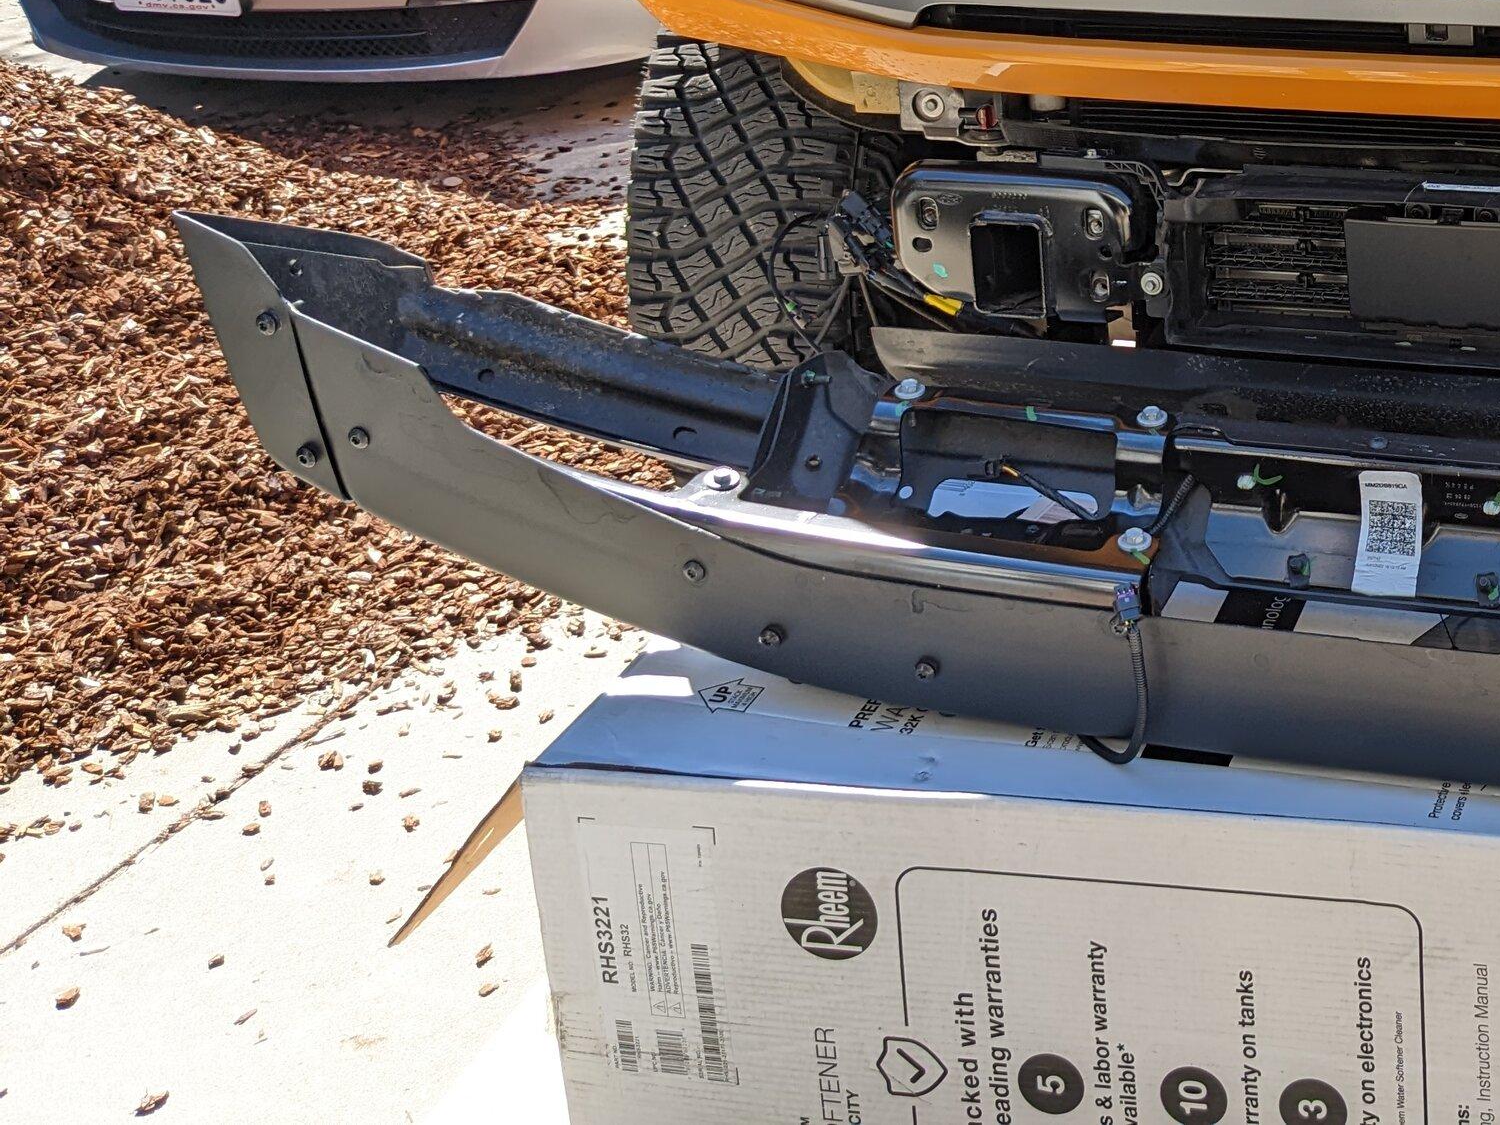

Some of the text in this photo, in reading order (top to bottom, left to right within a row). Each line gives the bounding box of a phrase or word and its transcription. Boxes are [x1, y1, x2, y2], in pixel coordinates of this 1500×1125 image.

[708, 686, 732, 703] UP
[899, 715, 925, 735] 32K
[1024, 732, 1044, 747] Get
[1428, 783, 1451, 819] Protective
[1451, 796, 1468, 821] covers
[783, 871, 864, 953] Rheem
[591, 895, 619, 985] RHS3221
[620, 924, 632, 957] RHS32
[979, 908, 1005, 1038] warranties
[1087, 940, 1108, 1031] warranty
[1473, 963, 1489, 1019] Manual
[1236, 970, 1255, 1028] tanks
[1354, 956, 1375, 1074] electronics
[954, 992, 977, 1048] with
[1393, 1011, 1403, 1044] Cleaner
[1093, 1037, 1112, 1089] labor
[1241, 1034, 1257, 1059] on
[1394, 1045, 1404, 1082] Softener
[1474, 1023, 1492, 1102] Instruction
[814, 1027, 843, 1125] FTENER
[1037, 1075, 1066, 1095] 5
[1360, 1079, 1376, 1105] on
[1094, 1095, 1113, 1110] &
[1178, 1080, 1208, 1116] 10
[1298, 1099, 1327, 1120] 3
[1396, 1084, 1406, 1109] Water
